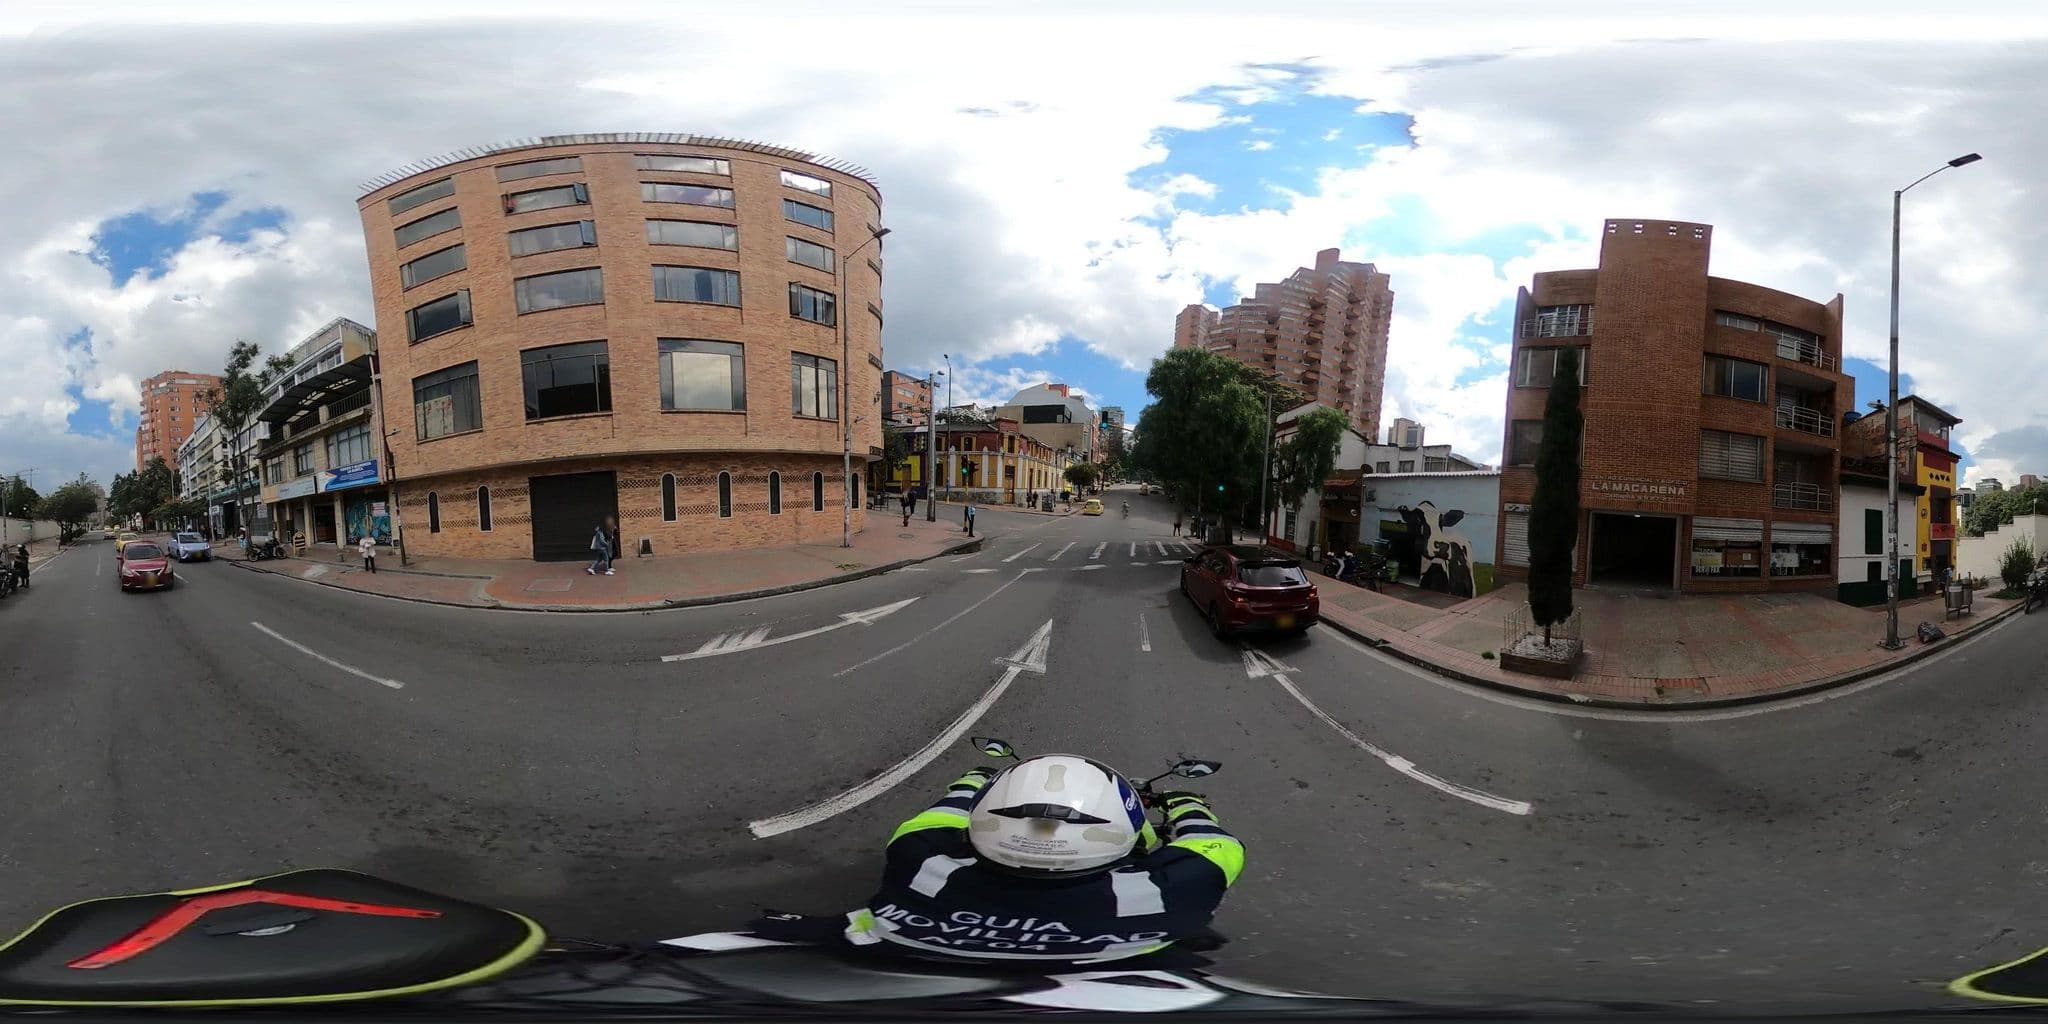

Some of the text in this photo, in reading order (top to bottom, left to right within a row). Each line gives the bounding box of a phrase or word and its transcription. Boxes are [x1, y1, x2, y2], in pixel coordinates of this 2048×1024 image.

[1592, 481, 1685, 496] LA MACARENA
[875, 904, 1169, 944] MOVILIDAD
[951, 910, 1072, 933] GUÍA
